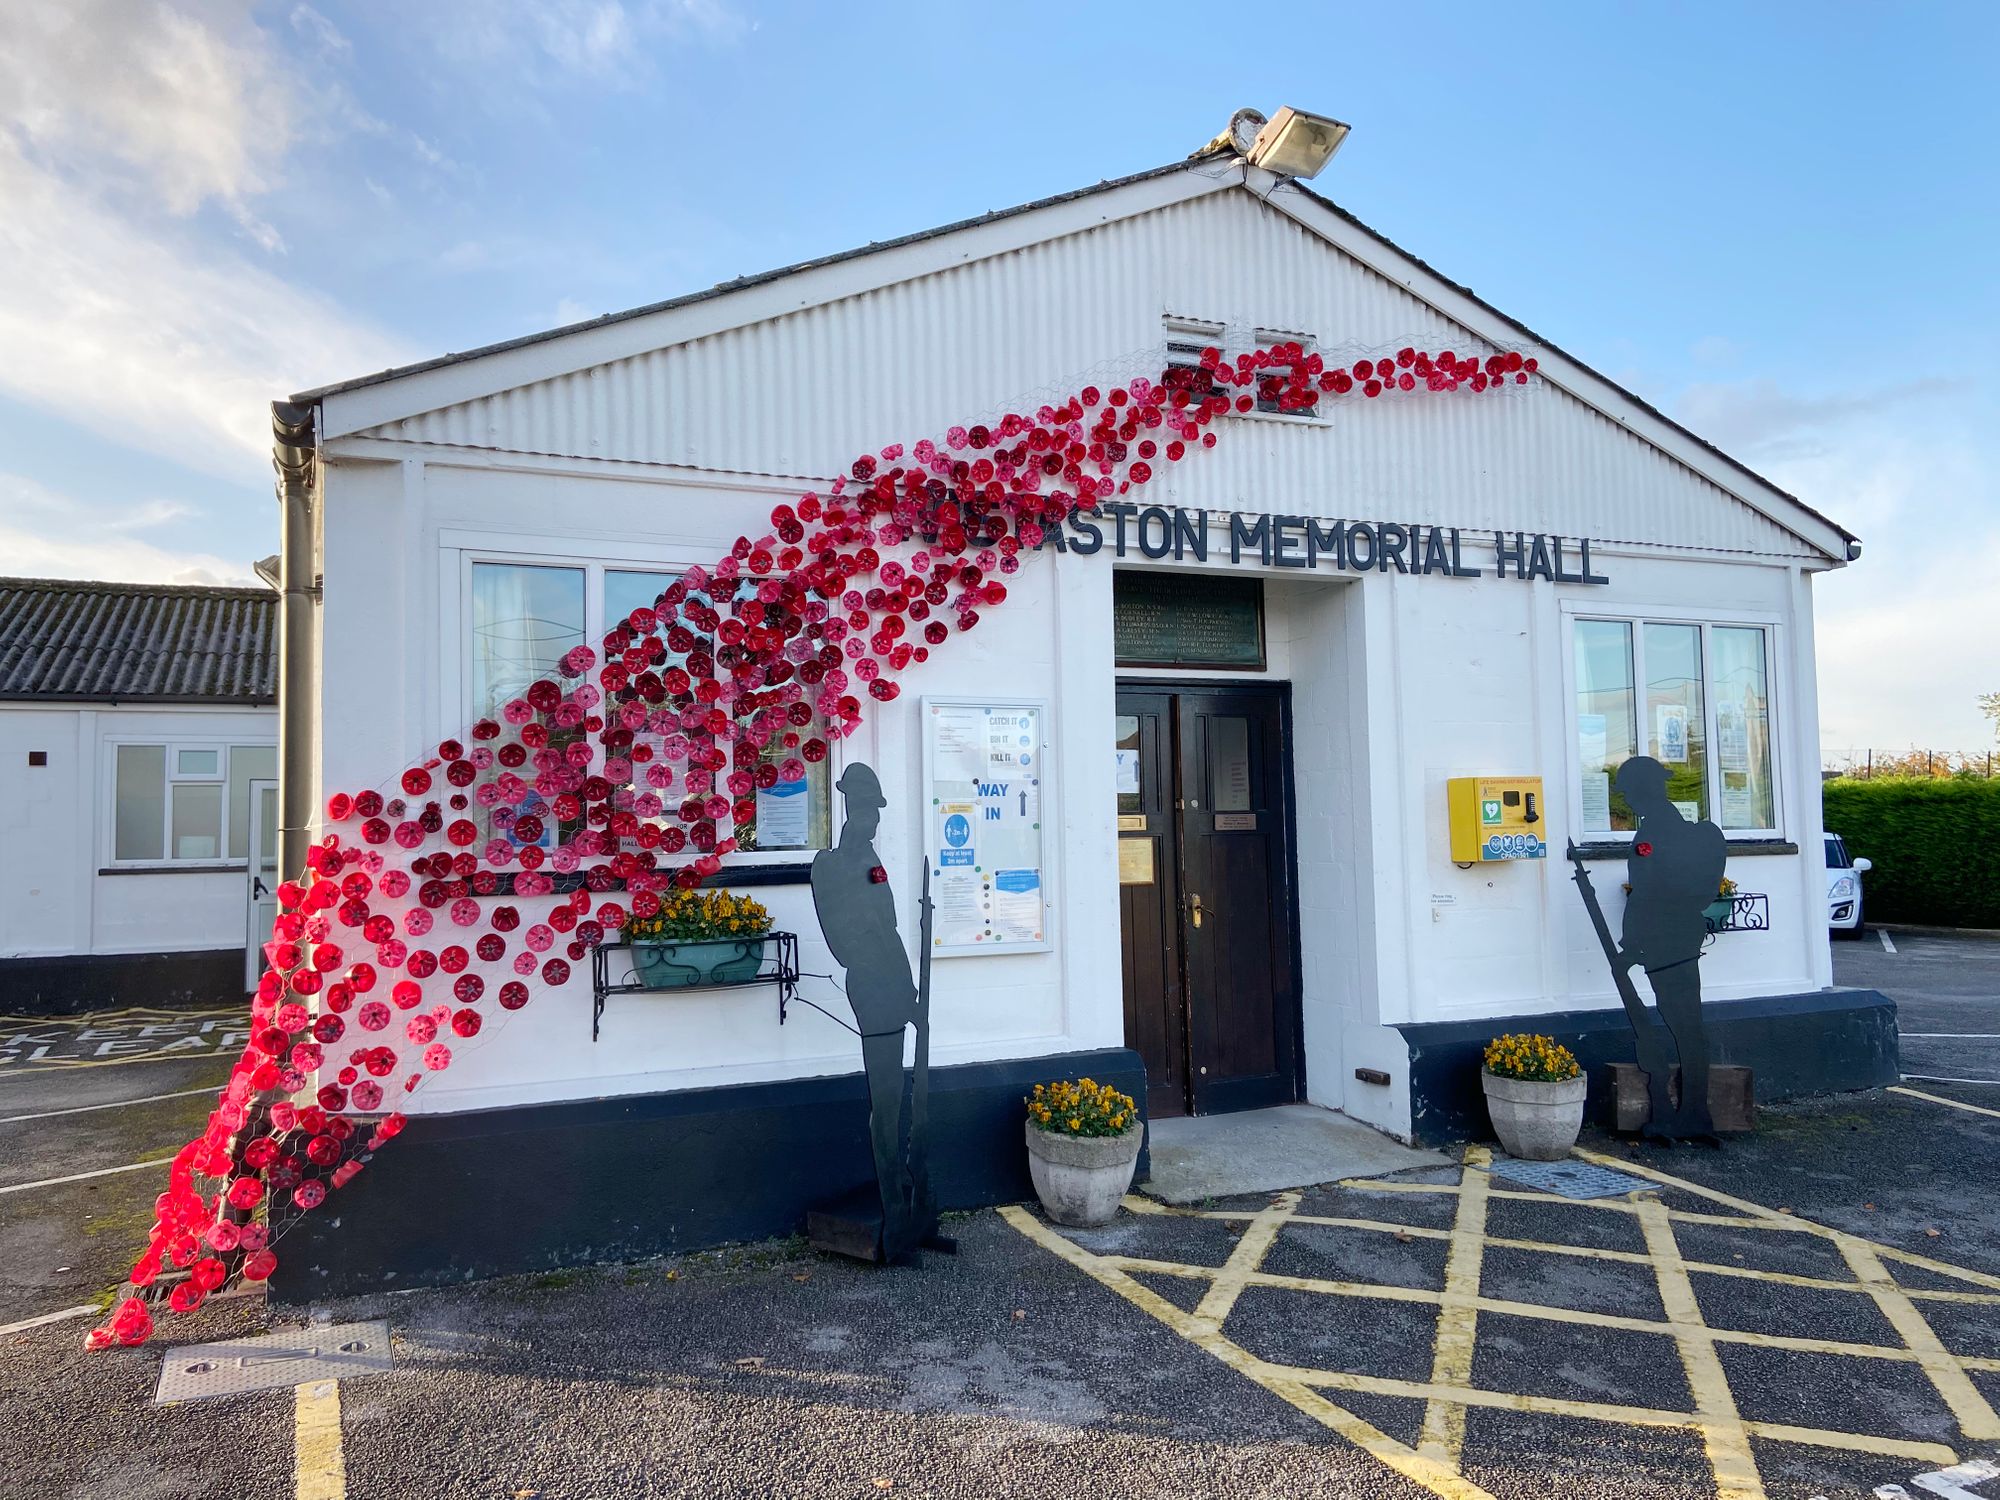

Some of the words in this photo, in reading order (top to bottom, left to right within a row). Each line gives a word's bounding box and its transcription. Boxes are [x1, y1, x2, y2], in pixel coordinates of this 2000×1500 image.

[893, 484, 1208, 563] ASTON
[1230, 511, 1481, 578] MEMORIAL
[1495, 530, 1609, 585] HALL
[989, 717, 1009, 726] CATCH
[1011, 717, 1018, 726] IT
[1002, 735, 1009, 744] IT
[990, 753, 1004, 762] KILL
[1005, 753, 1011, 762] IT
[977, 783, 1009, 797] WAY
[986, 807, 1001, 820] IN
[4, 1018, 248, 1047] KEEP
